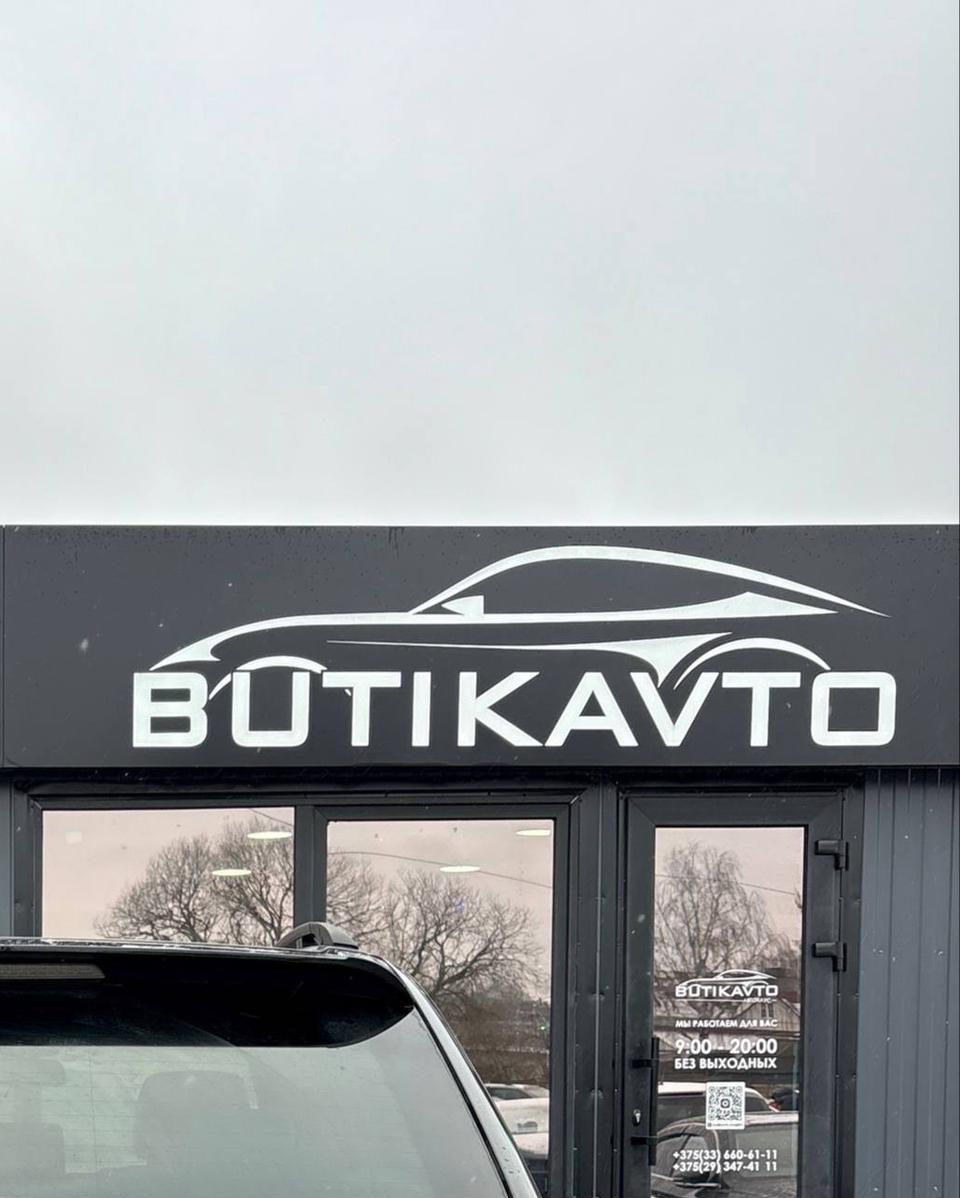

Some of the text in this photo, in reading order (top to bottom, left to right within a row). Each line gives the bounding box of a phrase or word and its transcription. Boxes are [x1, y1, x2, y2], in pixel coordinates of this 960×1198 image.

[133, 670, 897, 748] BUTIKAVTO
[675, 984, 779, 997] BUTIKAVTO
[675, 1019, 778, 1028] МЫ РАБОТАЕМ ДЛЯ ВАС
[675, 1039, 711, 1054] 9:00
[729, 1039, 778, 1054] 20:00
[674, 1058, 777, 1070] БЕЗ ВЫХОДНЫХ
[673, 1149, 778, 1161] +375(33) 660-61-11
[673, 1161, 721, 1174] +375(29)
